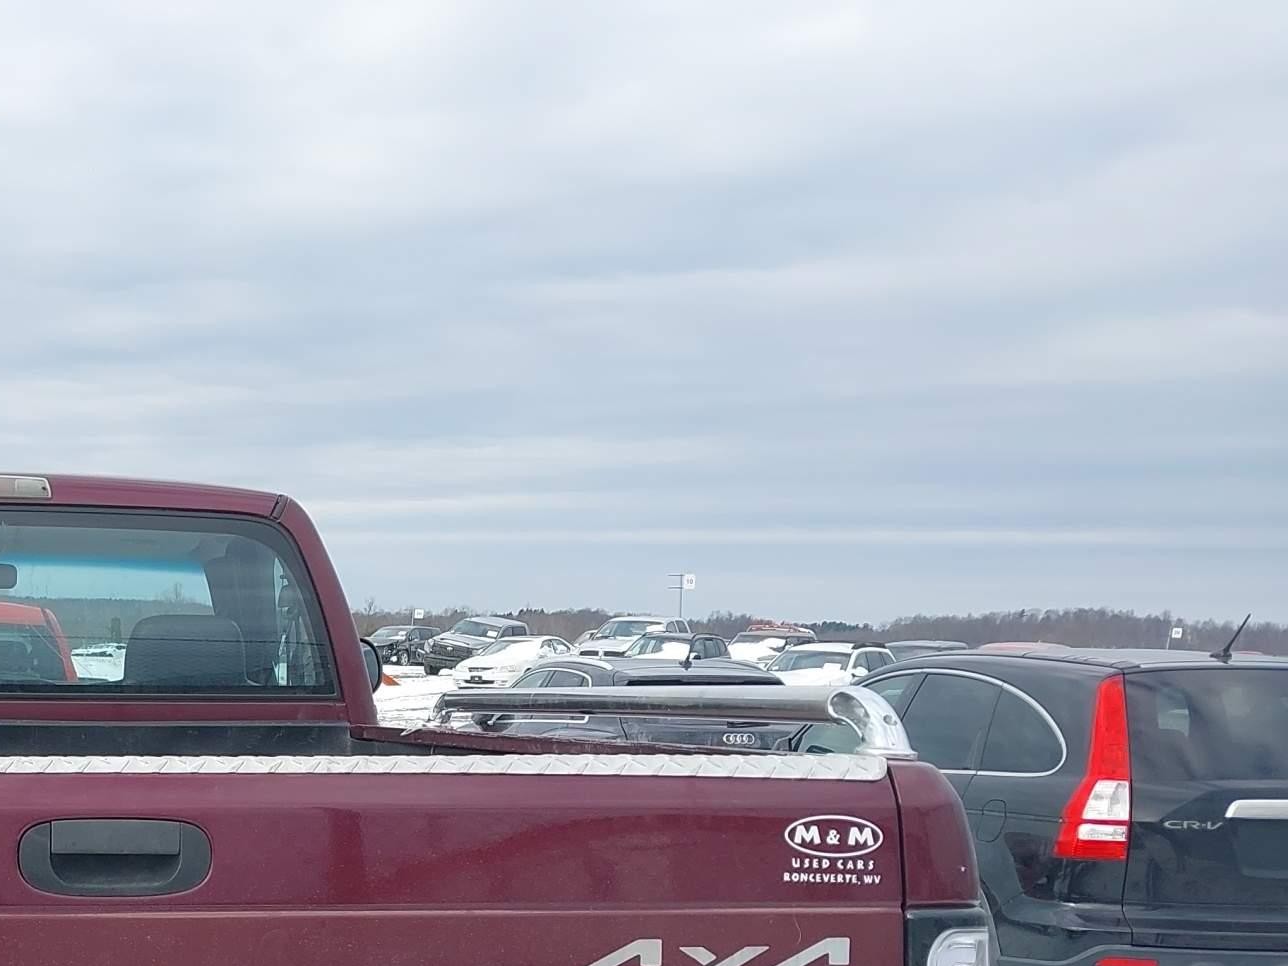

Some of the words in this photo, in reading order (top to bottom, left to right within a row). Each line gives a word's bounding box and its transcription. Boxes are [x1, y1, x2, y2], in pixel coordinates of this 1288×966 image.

[794, 825, 821, 845] M
[826, 829, 840, 845] &
[848, 826, 875, 846] M
[792, 858, 830, 870] USED
[837, 858, 876, 870] CARS
[783, 872, 861, 885] RONCEVERTE,
[863, 873, 881, 884] WV
